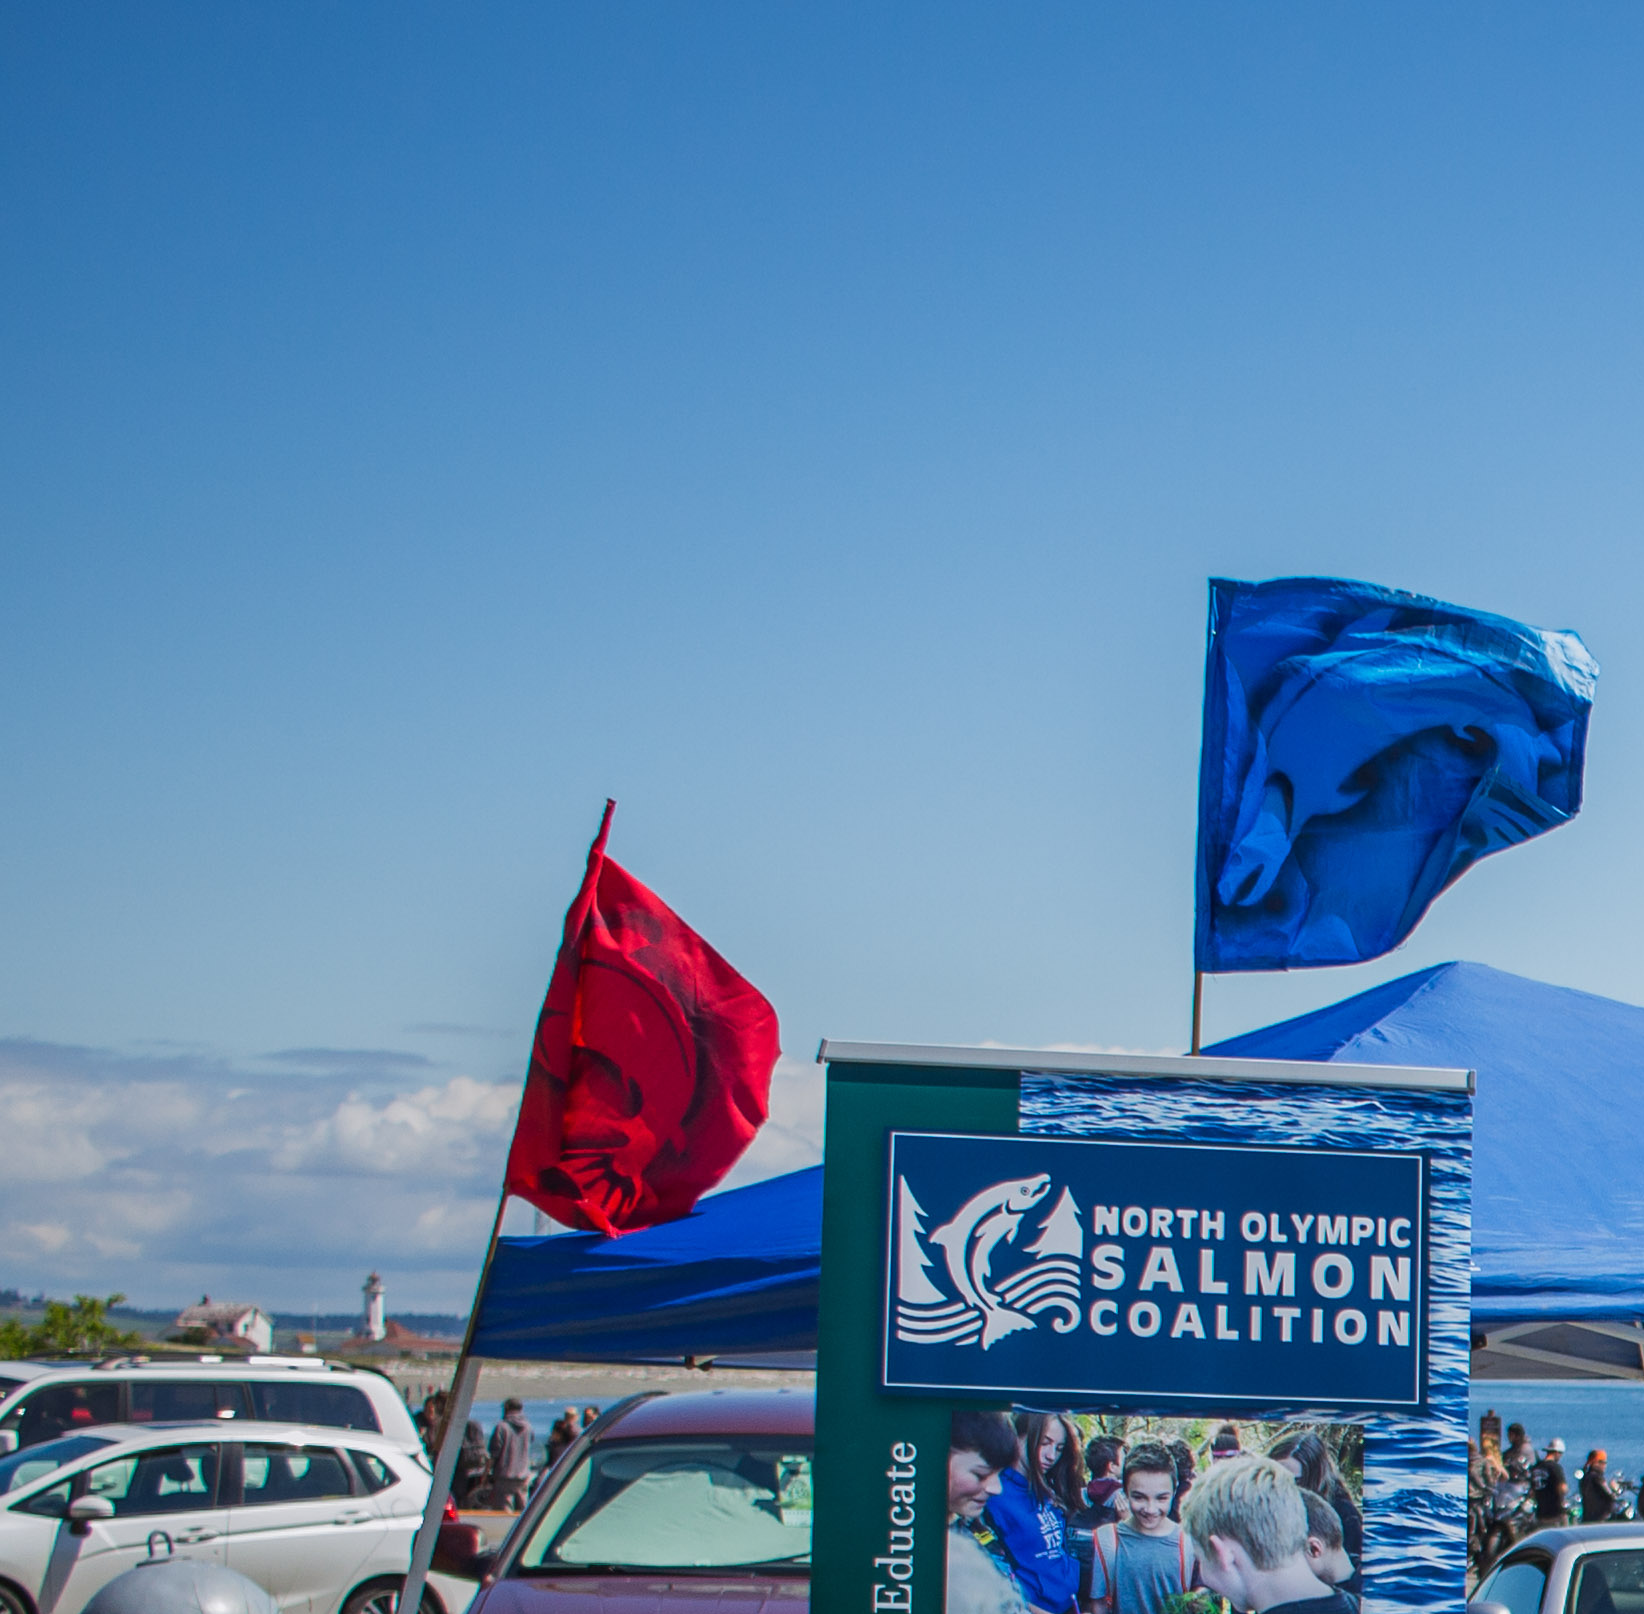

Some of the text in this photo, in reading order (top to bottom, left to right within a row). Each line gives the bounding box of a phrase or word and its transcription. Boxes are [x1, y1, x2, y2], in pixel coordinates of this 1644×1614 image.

[1093, 1206, 1411, 1248] NORTH OLYMPIC
[1092, 1245, 1411, 1301] SALMON
[1090, 1301, 1411, 1347] COALITION
[873, 1440, 917, 1614] Educate
